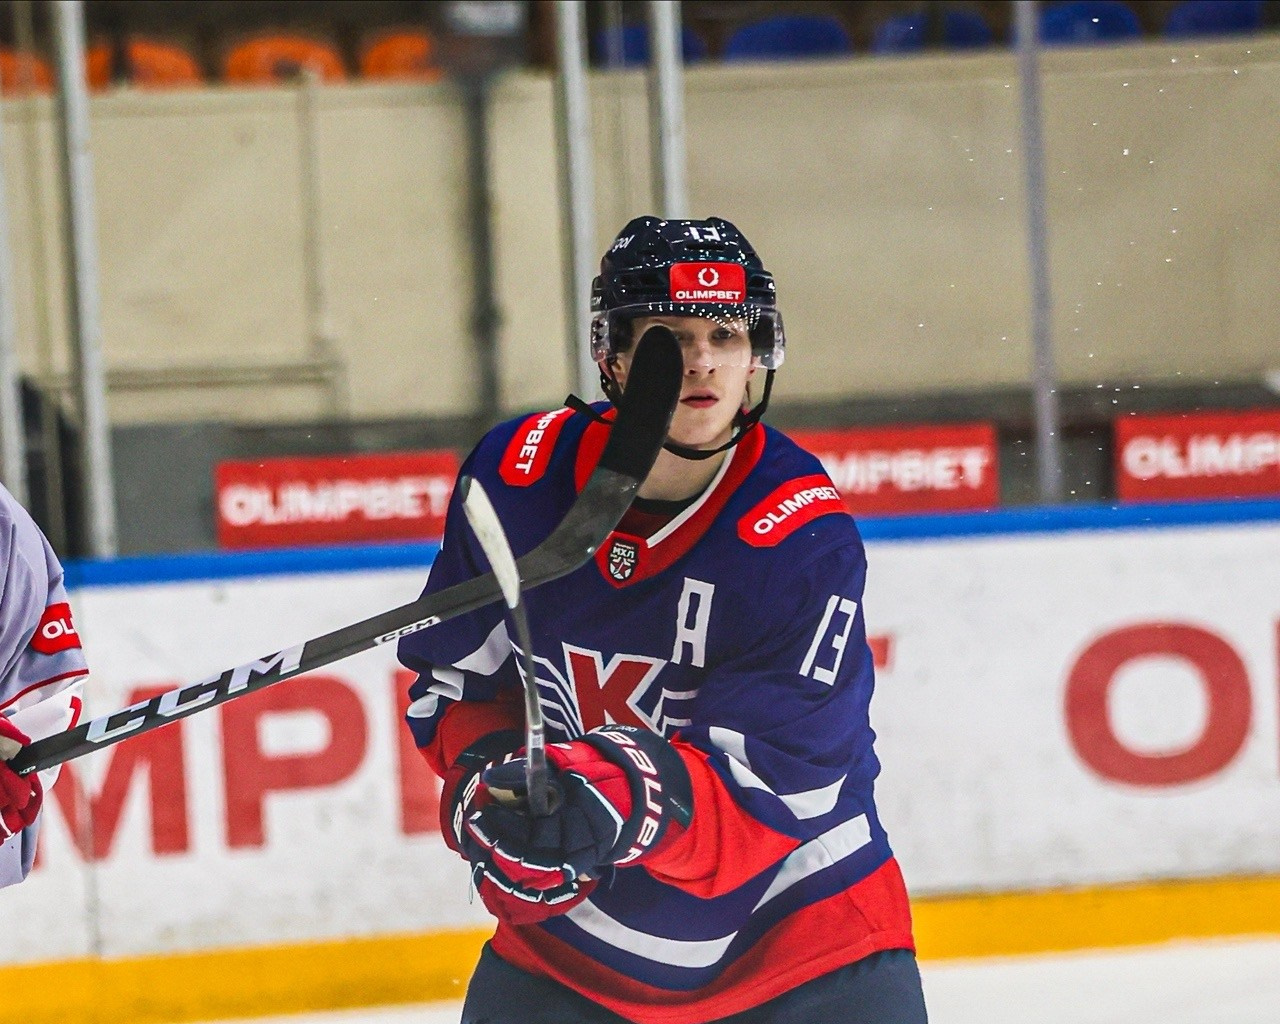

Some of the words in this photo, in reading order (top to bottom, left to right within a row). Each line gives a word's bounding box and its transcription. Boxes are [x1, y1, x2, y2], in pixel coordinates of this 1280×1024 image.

[675, 289, 742, 301] OLIMPBET
[220, 475, 453, 527] OLIMPBET
[379, 616, 438, 643] CCM
[670, 576, 716, 668] A
[798, 594, 858, 687] 13
[85, 641, 308, 745] CCM
